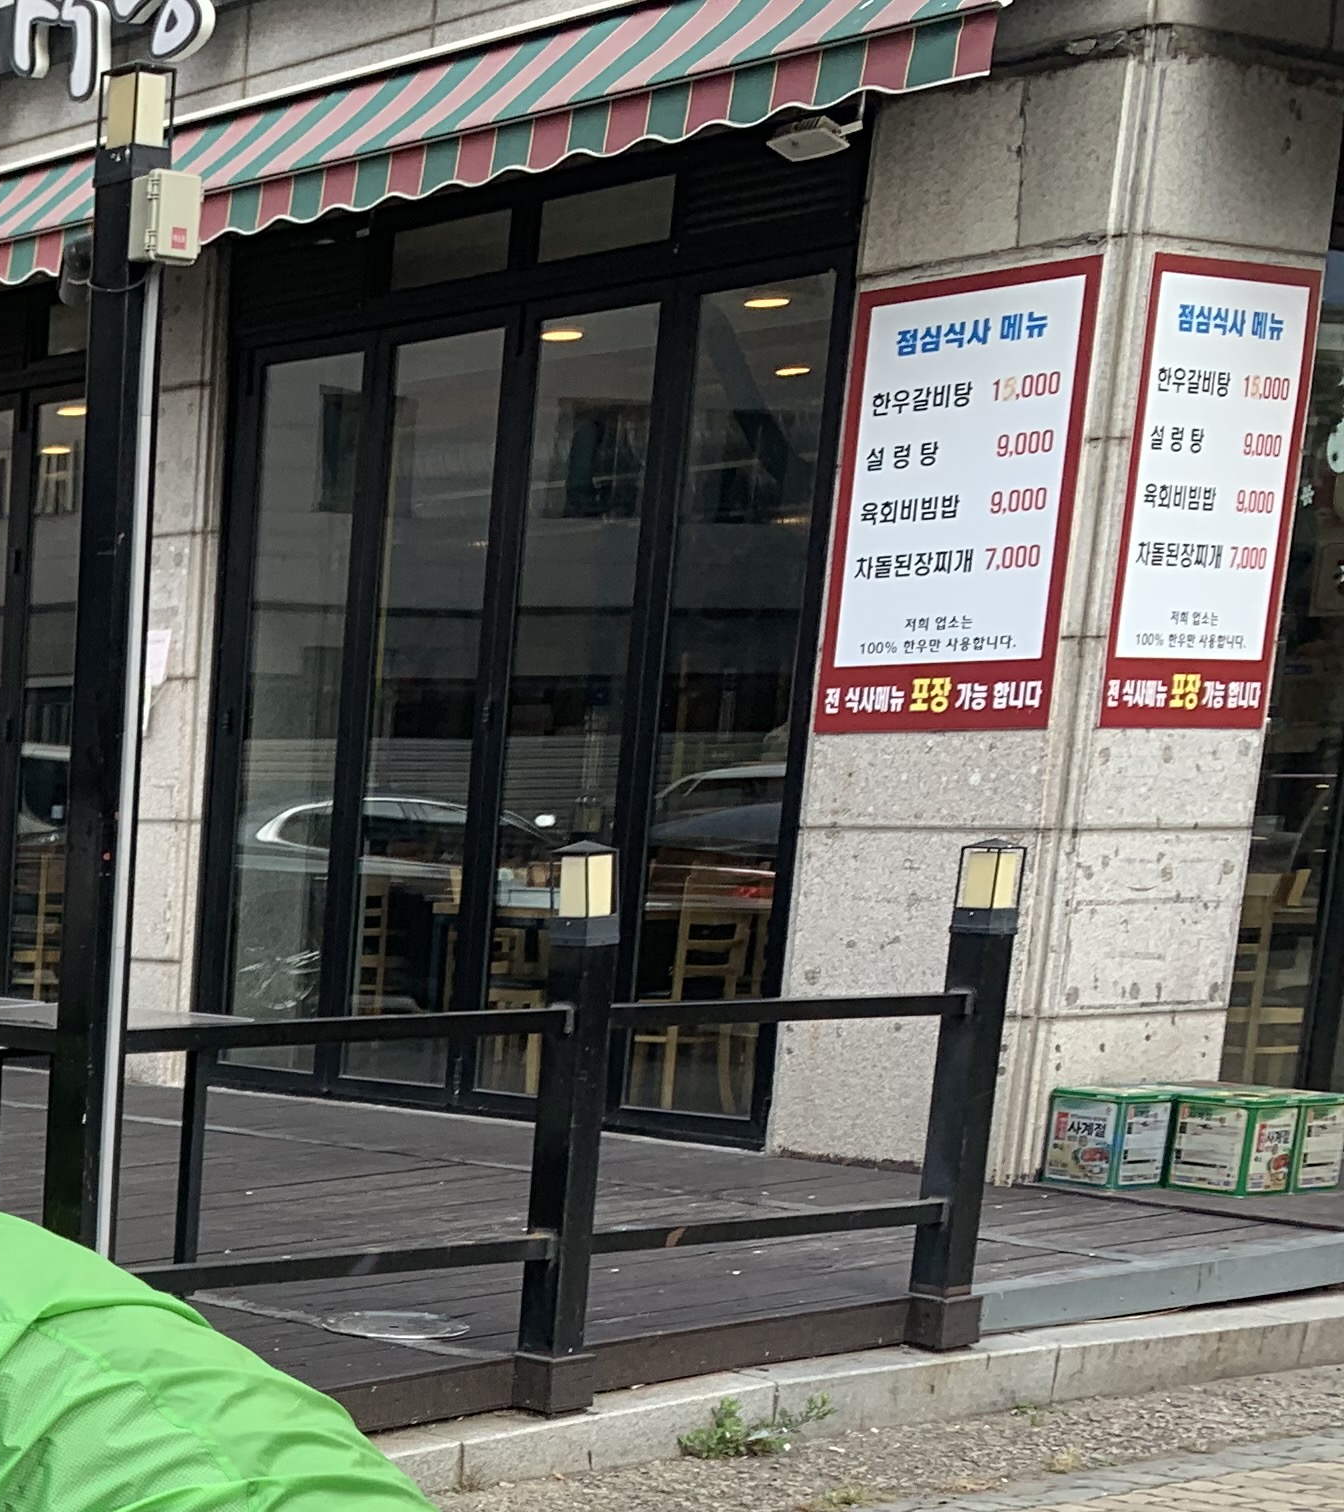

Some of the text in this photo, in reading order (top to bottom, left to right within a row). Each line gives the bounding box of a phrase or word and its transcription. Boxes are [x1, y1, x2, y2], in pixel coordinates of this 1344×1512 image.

[896, 311, 1048, 357] 점심식사 메뉴
[1179, 303, 1284, 340] 점심식사 메뉴
[1157, 366, 1231, 397] 한우갈비탕
[872, 381, 973, 417] 한우갈비탕
[996, 428, 1054, 458] 9,000
[1242, 432, 1282, 457] 9,000
[860, 486, 1047, 526] 육회비빔밥 9,000
[1143, 483, 1275, 514] 육회비빔밥 9,000
[854, 544, 1041, 580] 차돌된장찌개 7,000
[1135, 541, 1268, 571] 차돌된장찌개 7,000
[904, 614, 973, 632] 저희 업소는
[1170, 610, 1219, 627] 저희 업소는
[859, 635, 1017, 655] 100% 한우만 사용합니다.
[1135, 632, 1247, 650] 100% 한우만 사용합니다.
[824, 676, 1043, 714] 전 식사메뉴 포장 가능 합니다
[1107, 673, 1262, 710] 전 식사메뉴 포장 가능 합니다
[1068, 1120, 1107, 1139] 사계절
